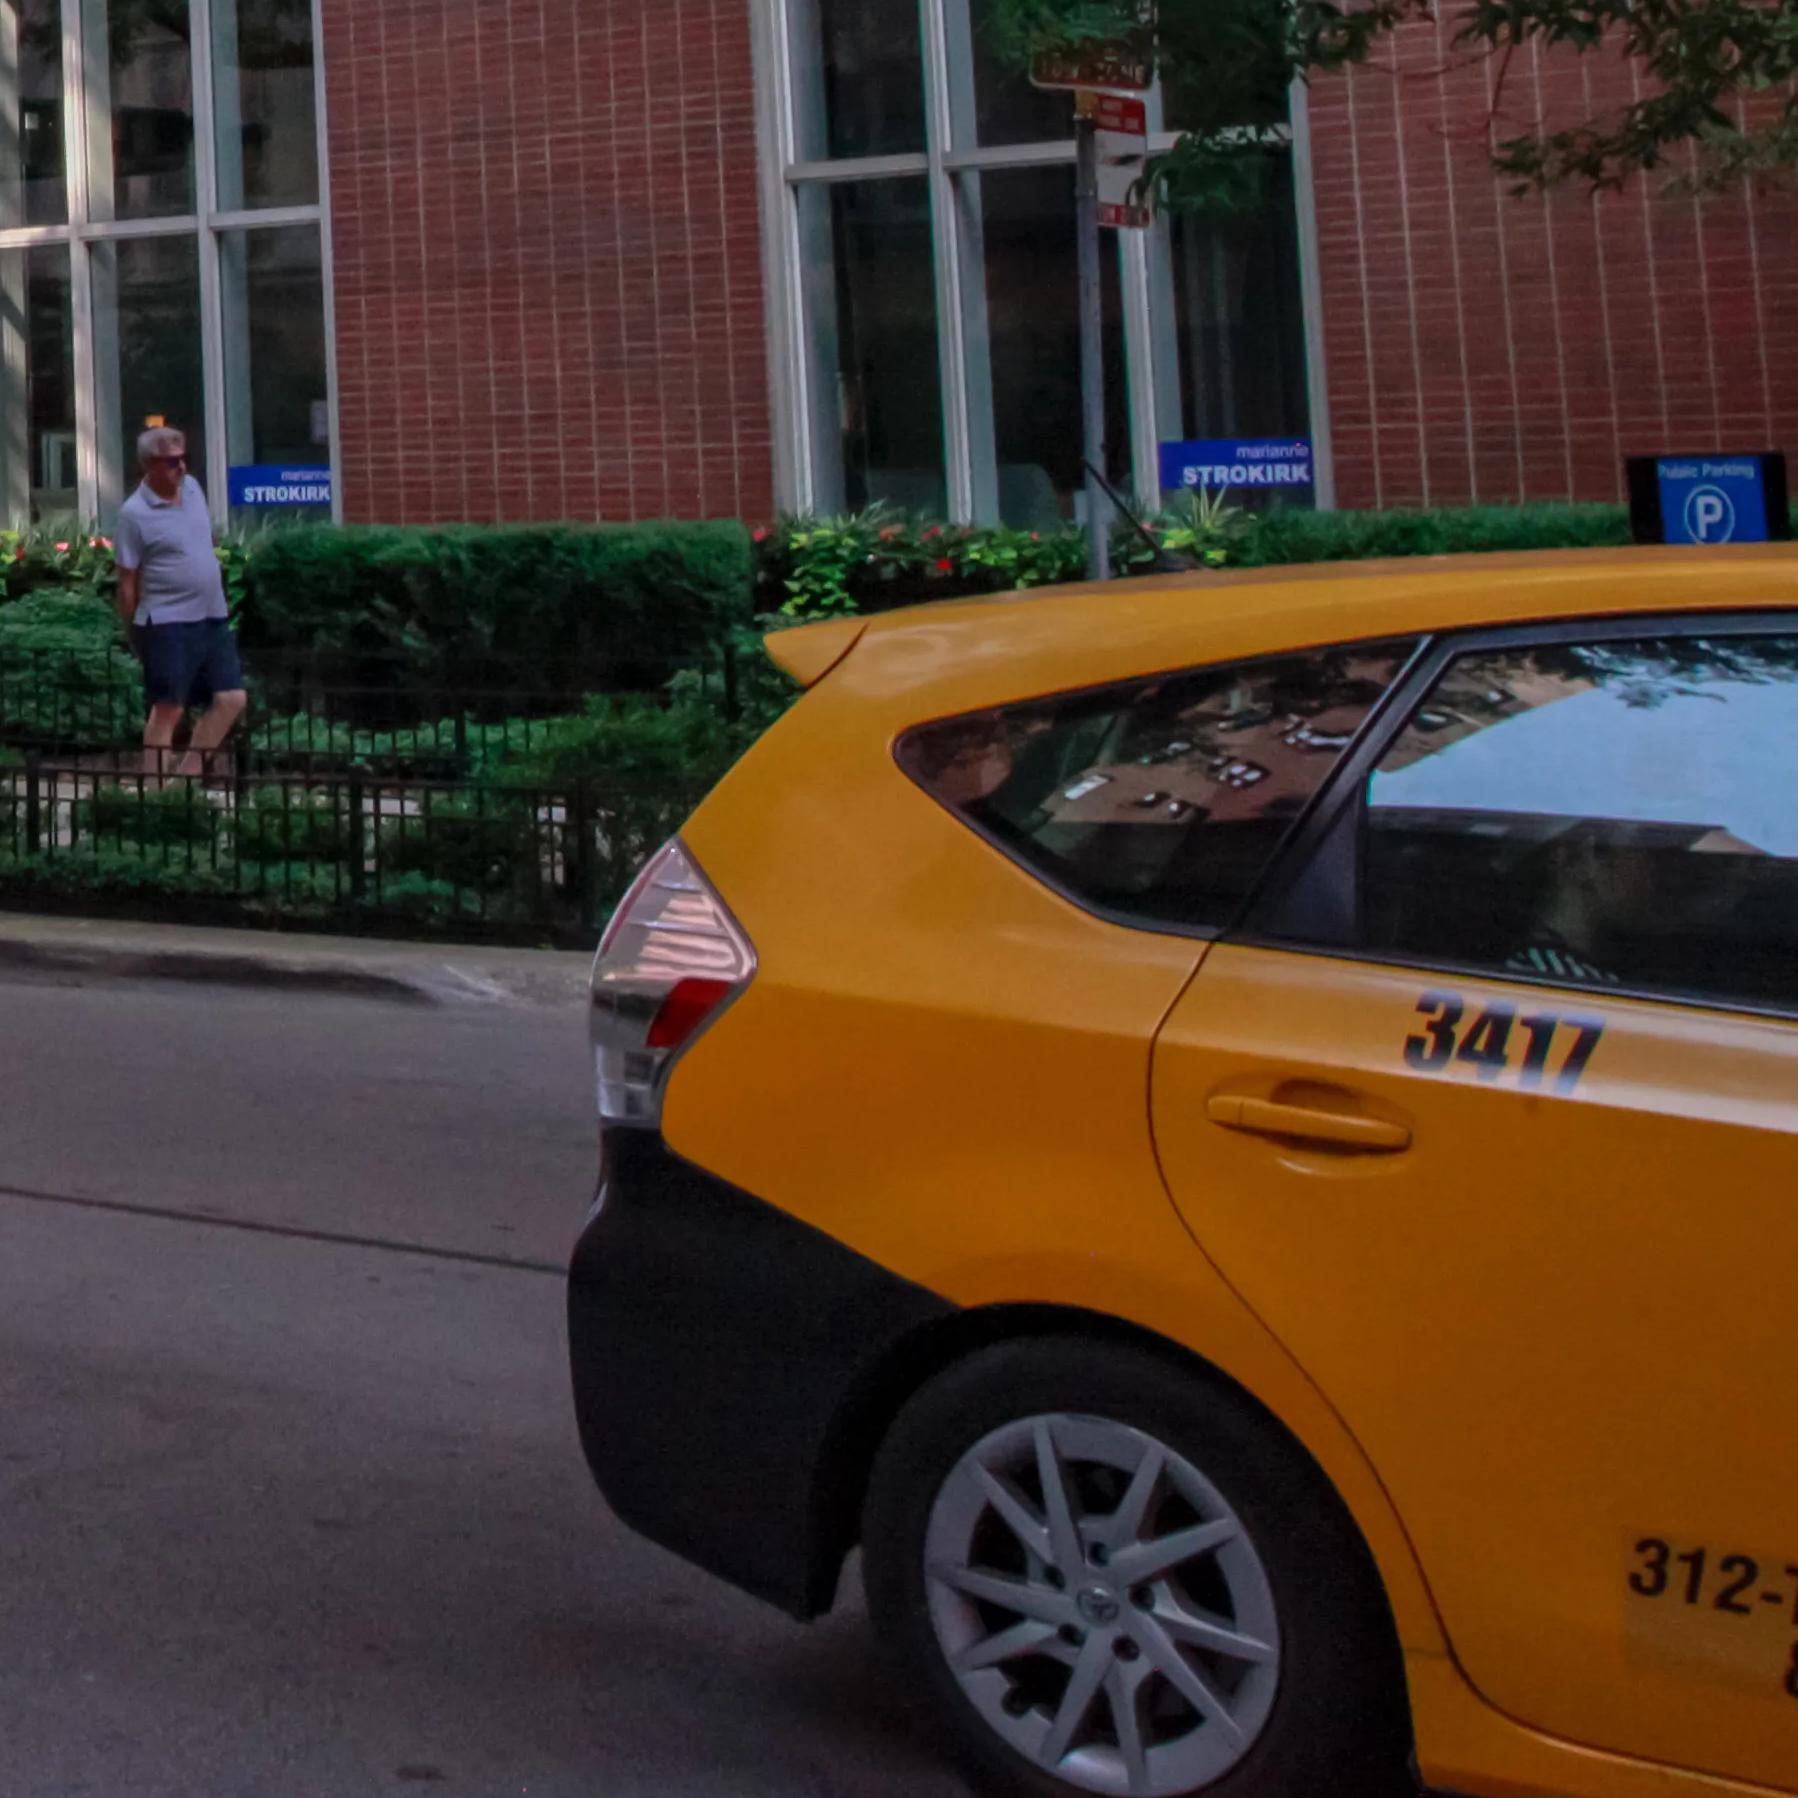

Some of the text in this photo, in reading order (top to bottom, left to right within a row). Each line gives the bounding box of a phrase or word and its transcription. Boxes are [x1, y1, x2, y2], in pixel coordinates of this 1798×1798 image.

[1183, 463, 1310, 485] STROKIRK
[1659, 463, 1754, 479] Public Parking
[244, 486, 331, 502] STROKIRK
[1404, 988, 1607, 1096] 3417
